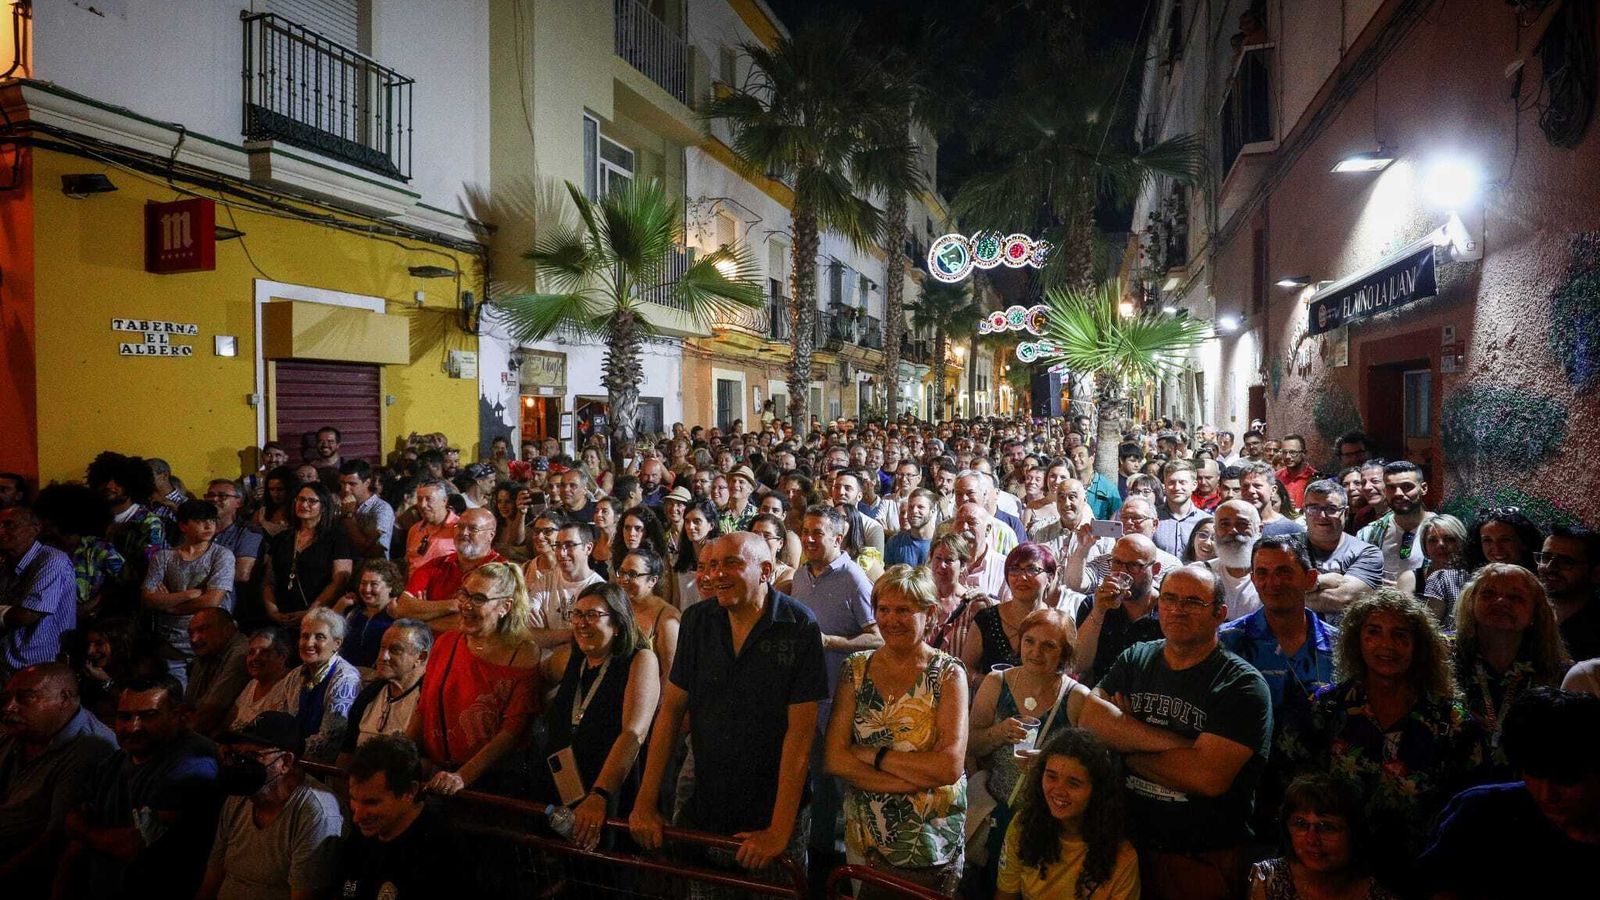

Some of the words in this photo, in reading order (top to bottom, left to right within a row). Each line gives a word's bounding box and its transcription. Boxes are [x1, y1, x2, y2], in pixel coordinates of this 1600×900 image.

[1343, 296, 1352, 318] EL
[1352, 285, 1374, 316] NIÑO
[1375, 281, 1387, 307] LA
[113, 319, 198, 335] TABERNA
[146, 333, 168, 344] EL
[121, 344, 192, 356] ALBERO
[1130, 692, 1207, 731] TROIT
